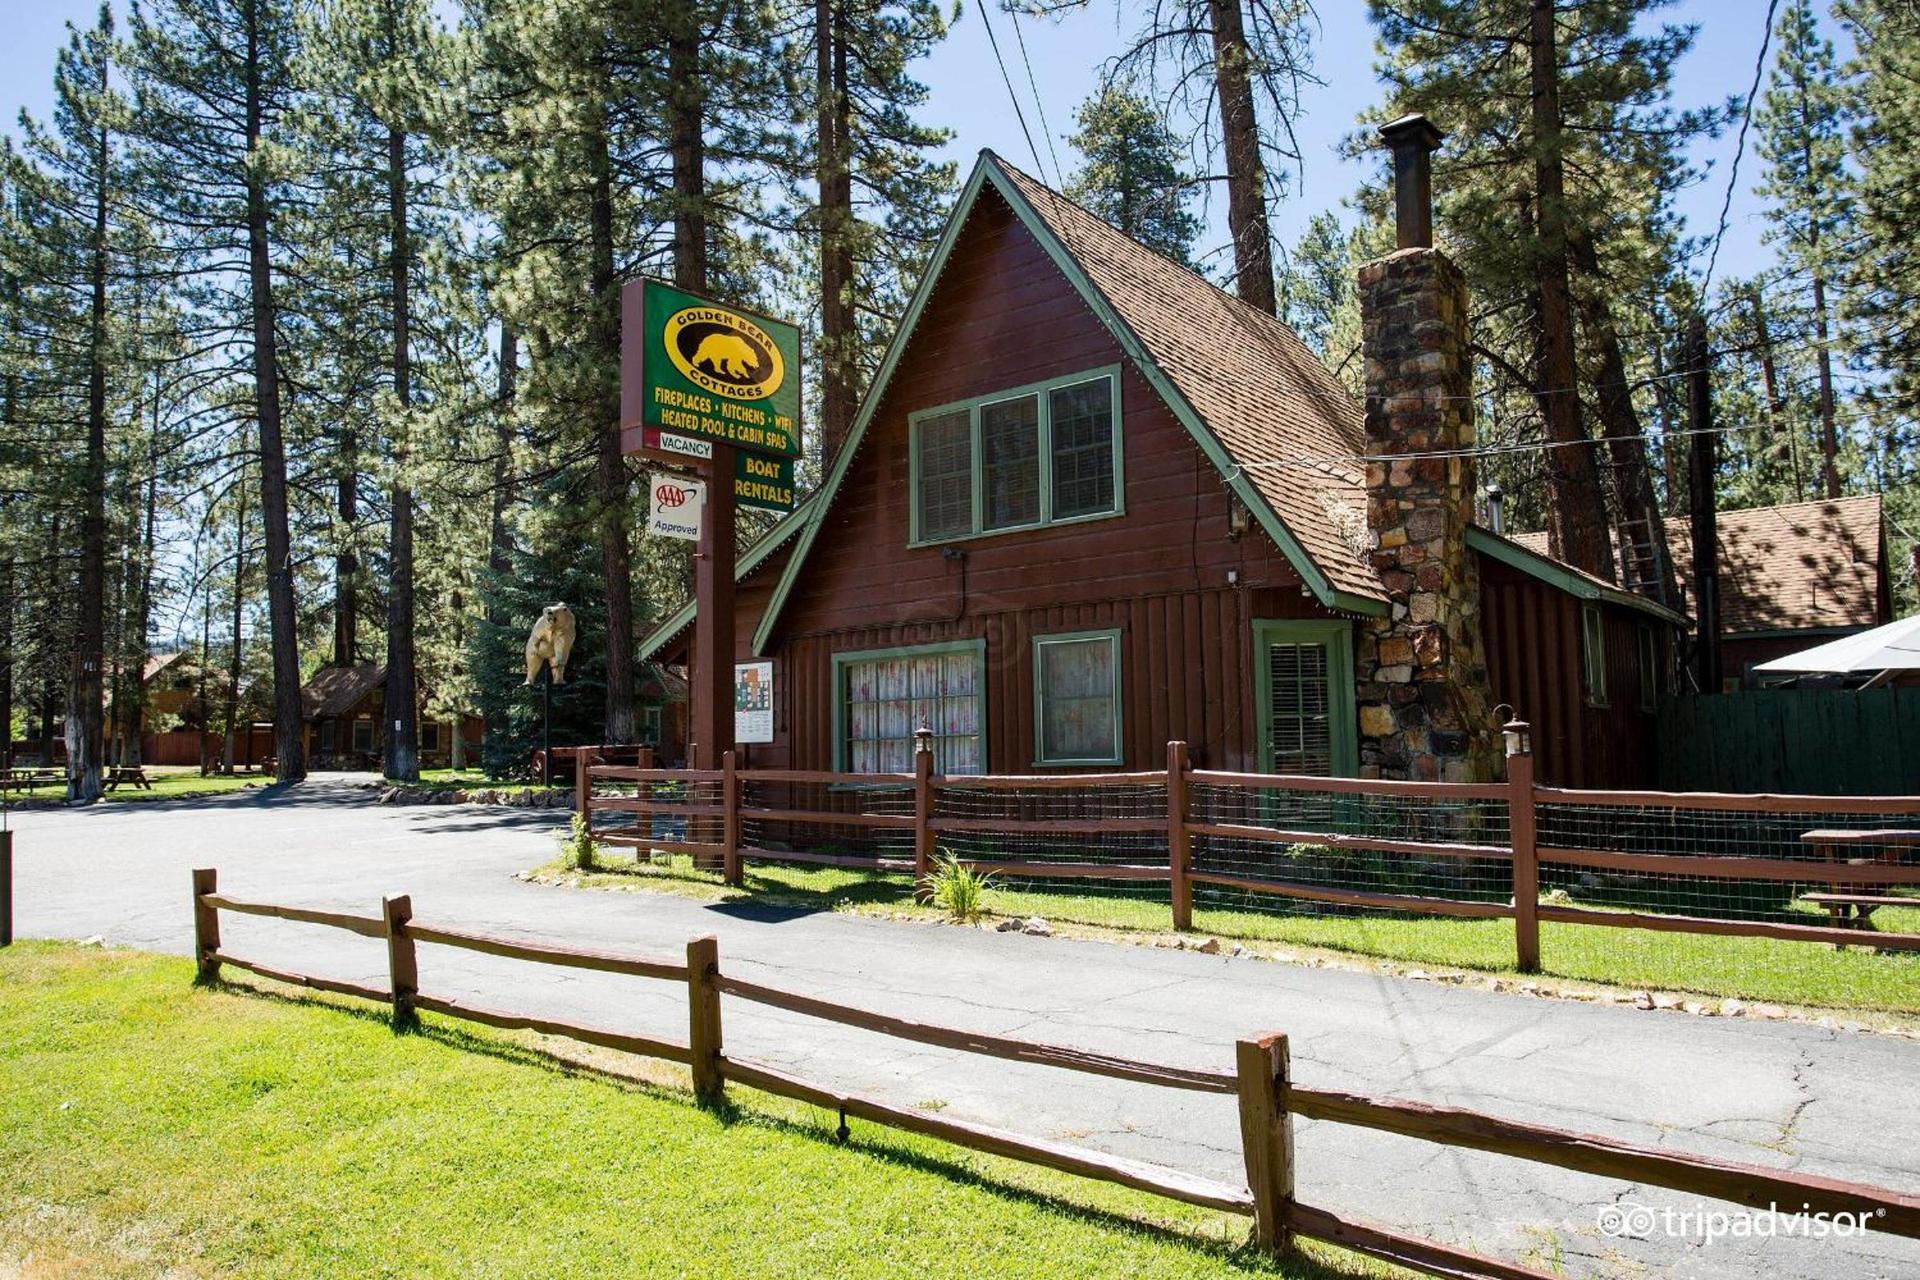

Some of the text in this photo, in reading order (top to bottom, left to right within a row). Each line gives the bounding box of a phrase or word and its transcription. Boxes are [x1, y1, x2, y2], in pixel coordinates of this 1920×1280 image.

[677, 311, 774, 352] GOLDEN BEAR
[689, 370, 763, 397] COTTAGES
[655, 387, 793, 431] FIREPLACES KITCHENS WIFI
[661, 409, 786, 450] HEATED POOL & CABIN SPAS
[661, 437, 711, 455] VACANCY
[746, 457, 780, 478] BOAT
[656, 486, 684, 505] AAA
[735, 482, 791, 505] RENTALS
[654, 520, 697, 535] Approved
